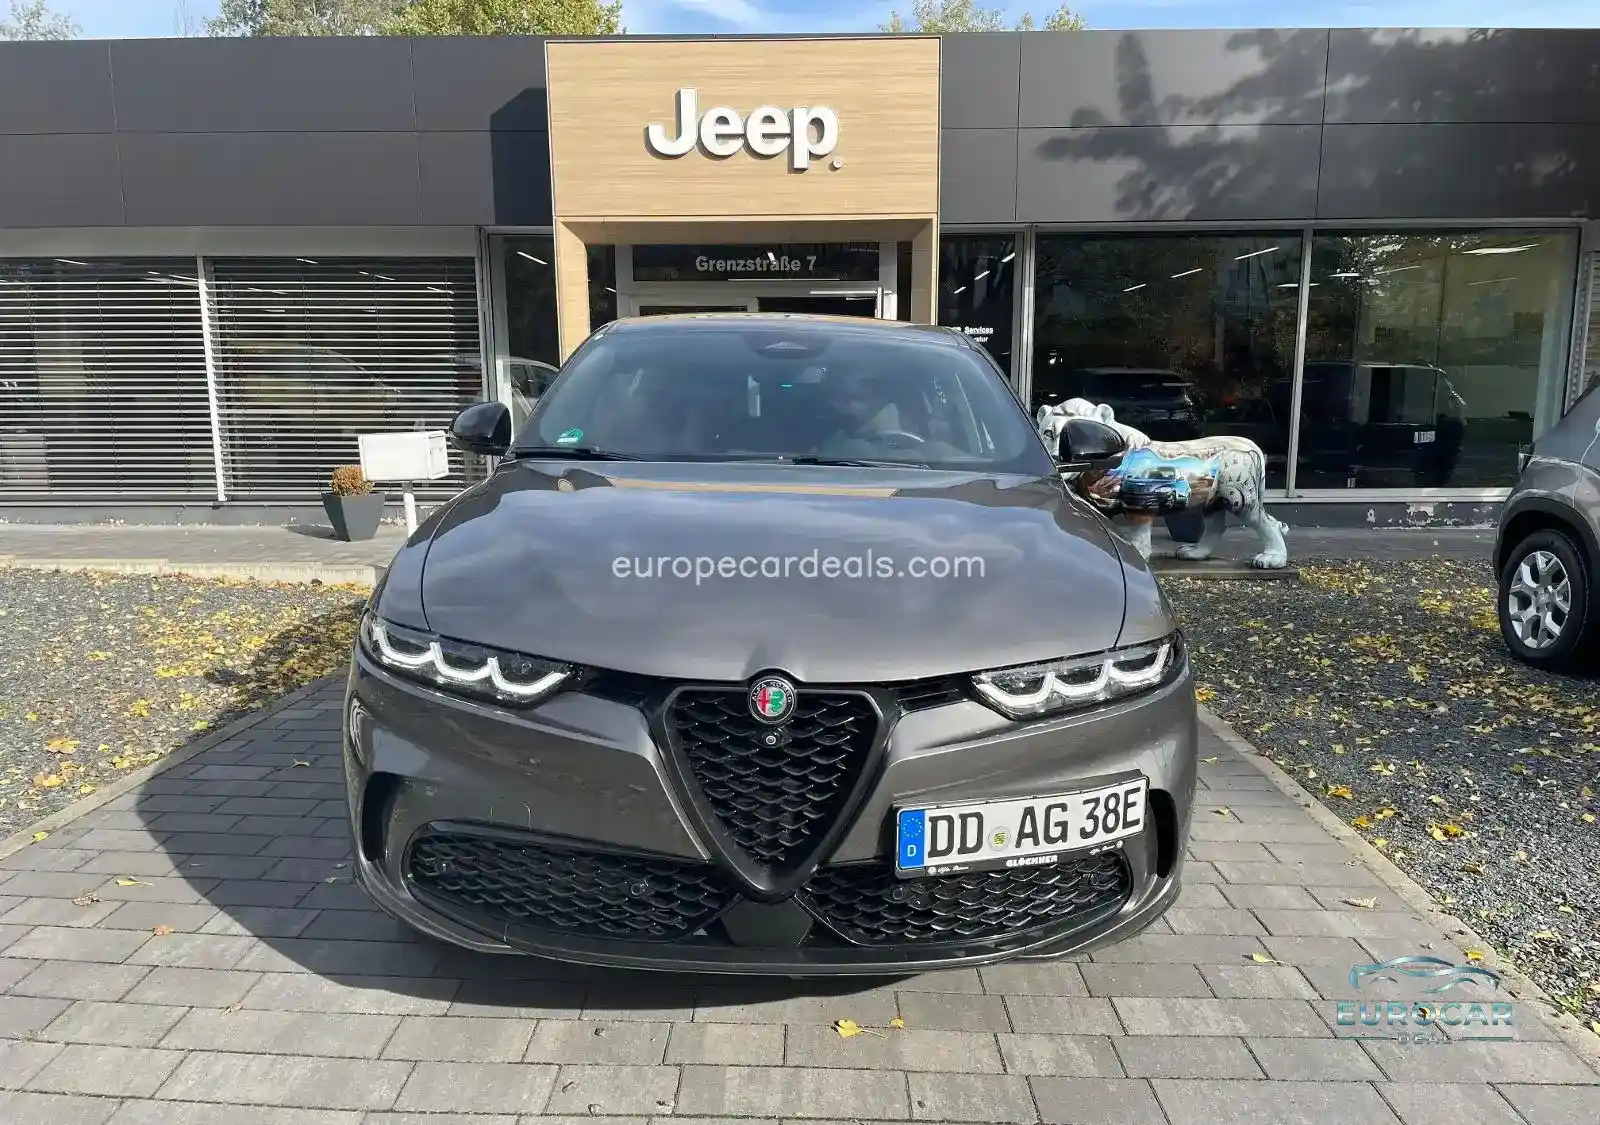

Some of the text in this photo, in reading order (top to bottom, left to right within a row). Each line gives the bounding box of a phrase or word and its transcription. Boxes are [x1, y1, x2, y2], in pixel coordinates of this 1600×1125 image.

[646, 87, 839, 171] Jeep
[695, 255, 817, 272] Grenzstraße 7
[964, 326, 993, 334] Services
[927, 787, 1141, 858] DD AG 38E
[906, 845, 917, 857] D
